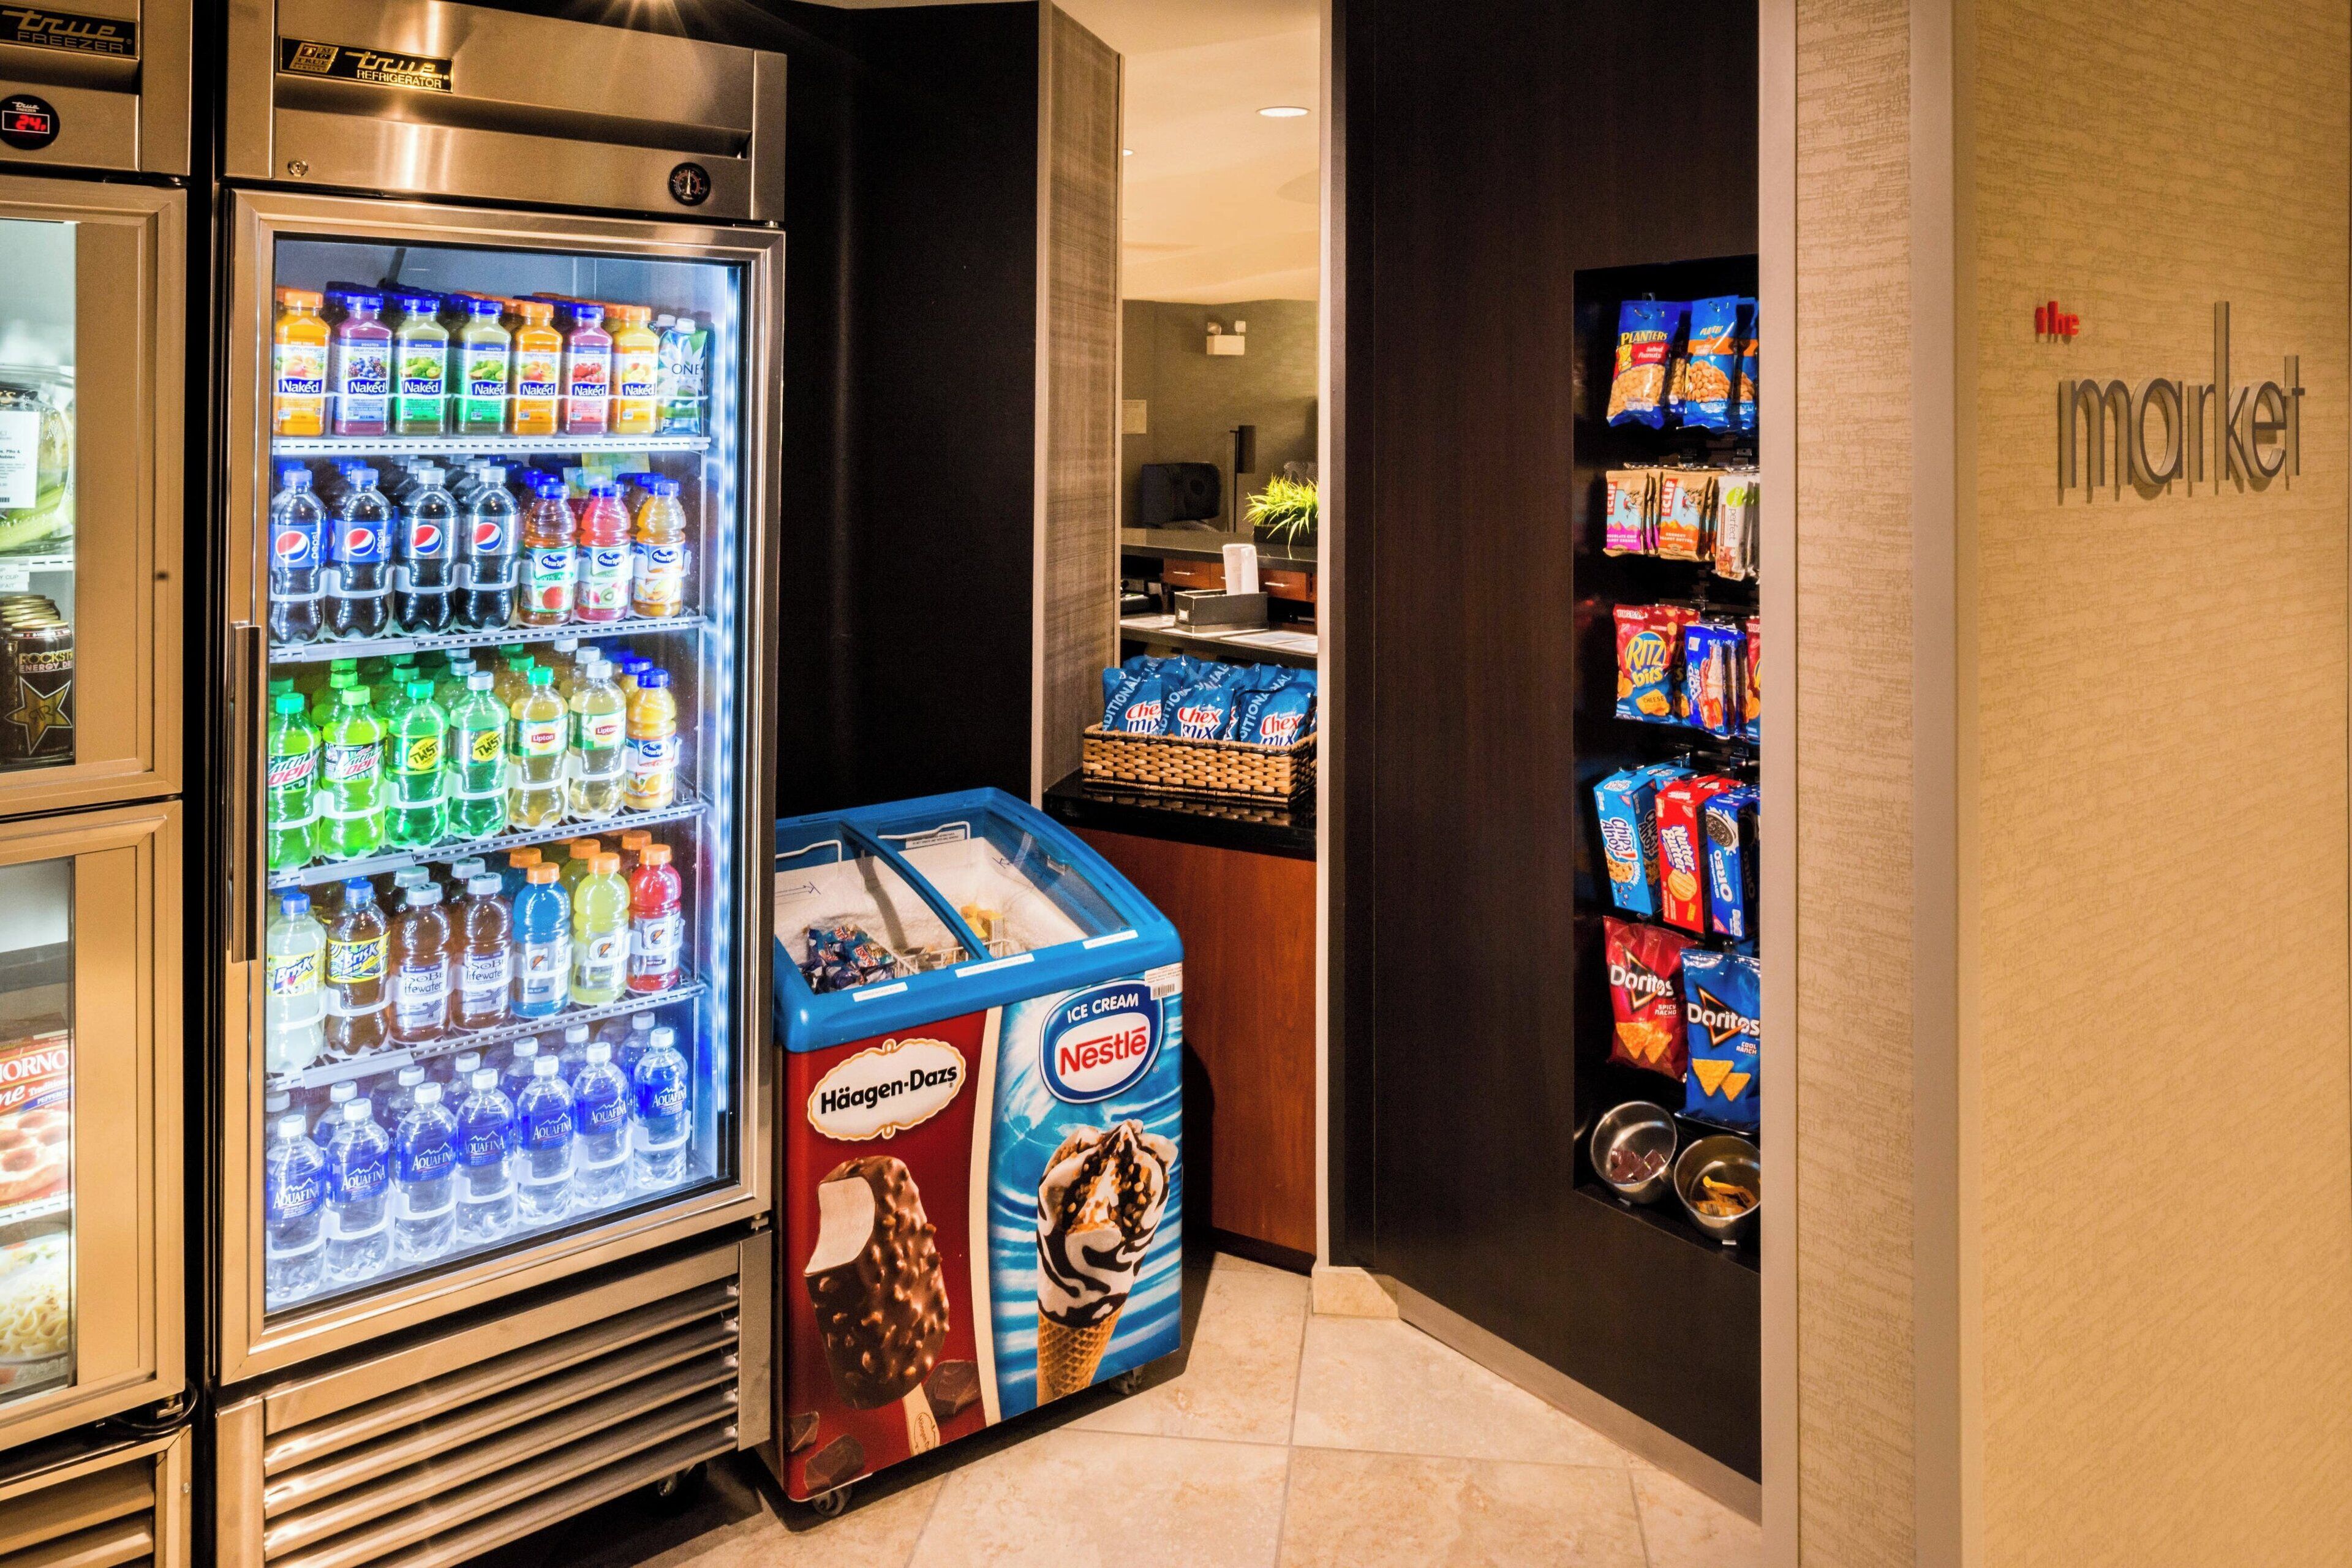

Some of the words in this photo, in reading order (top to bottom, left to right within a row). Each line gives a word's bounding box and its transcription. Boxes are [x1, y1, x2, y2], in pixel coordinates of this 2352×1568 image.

[17, 31, 123, 53] FREEZER
[356, 69, 442, 88] REFRIGERATOR
[2035, 301, 2079, 336] the
[672, 363, 699, 375] ONE
[2057, 301, 2305, 488] market
[1662, 480, 1675, 508] CLIF
[1728, 508, 1739, 541] perfect
[20, 662, 59, 673] ENERGY
[1626, 638, 1666, 671] RITZ
[1633, 667, 1664, 687] bits
[1178, 707, 1223, 724] Chex
[1262, 715, 1303, 735] Chex
[533, 734, 554, 743] Lipton
[1611, 818, 1633, 852] Chips
[1714, 850, 1733, 902] OREO
[1610, 965, 1674, 997] Doritos
[1067, 1000, 1088, 1023] ICE
[1091, 993, 1140, 1016] CREAM
[1687, 1003, 1760, 1036] Doritos
[1060, 1026, 1147, 1076] Nestlé
[1736, 1046, 1757, 1055] RANCH
[821, 1065, 957, 1114] Häagen-Dazs
[532, 1117, 572, 1140] AQUAFINA
[341, 1167, 386, 1191] AQUAFINA
